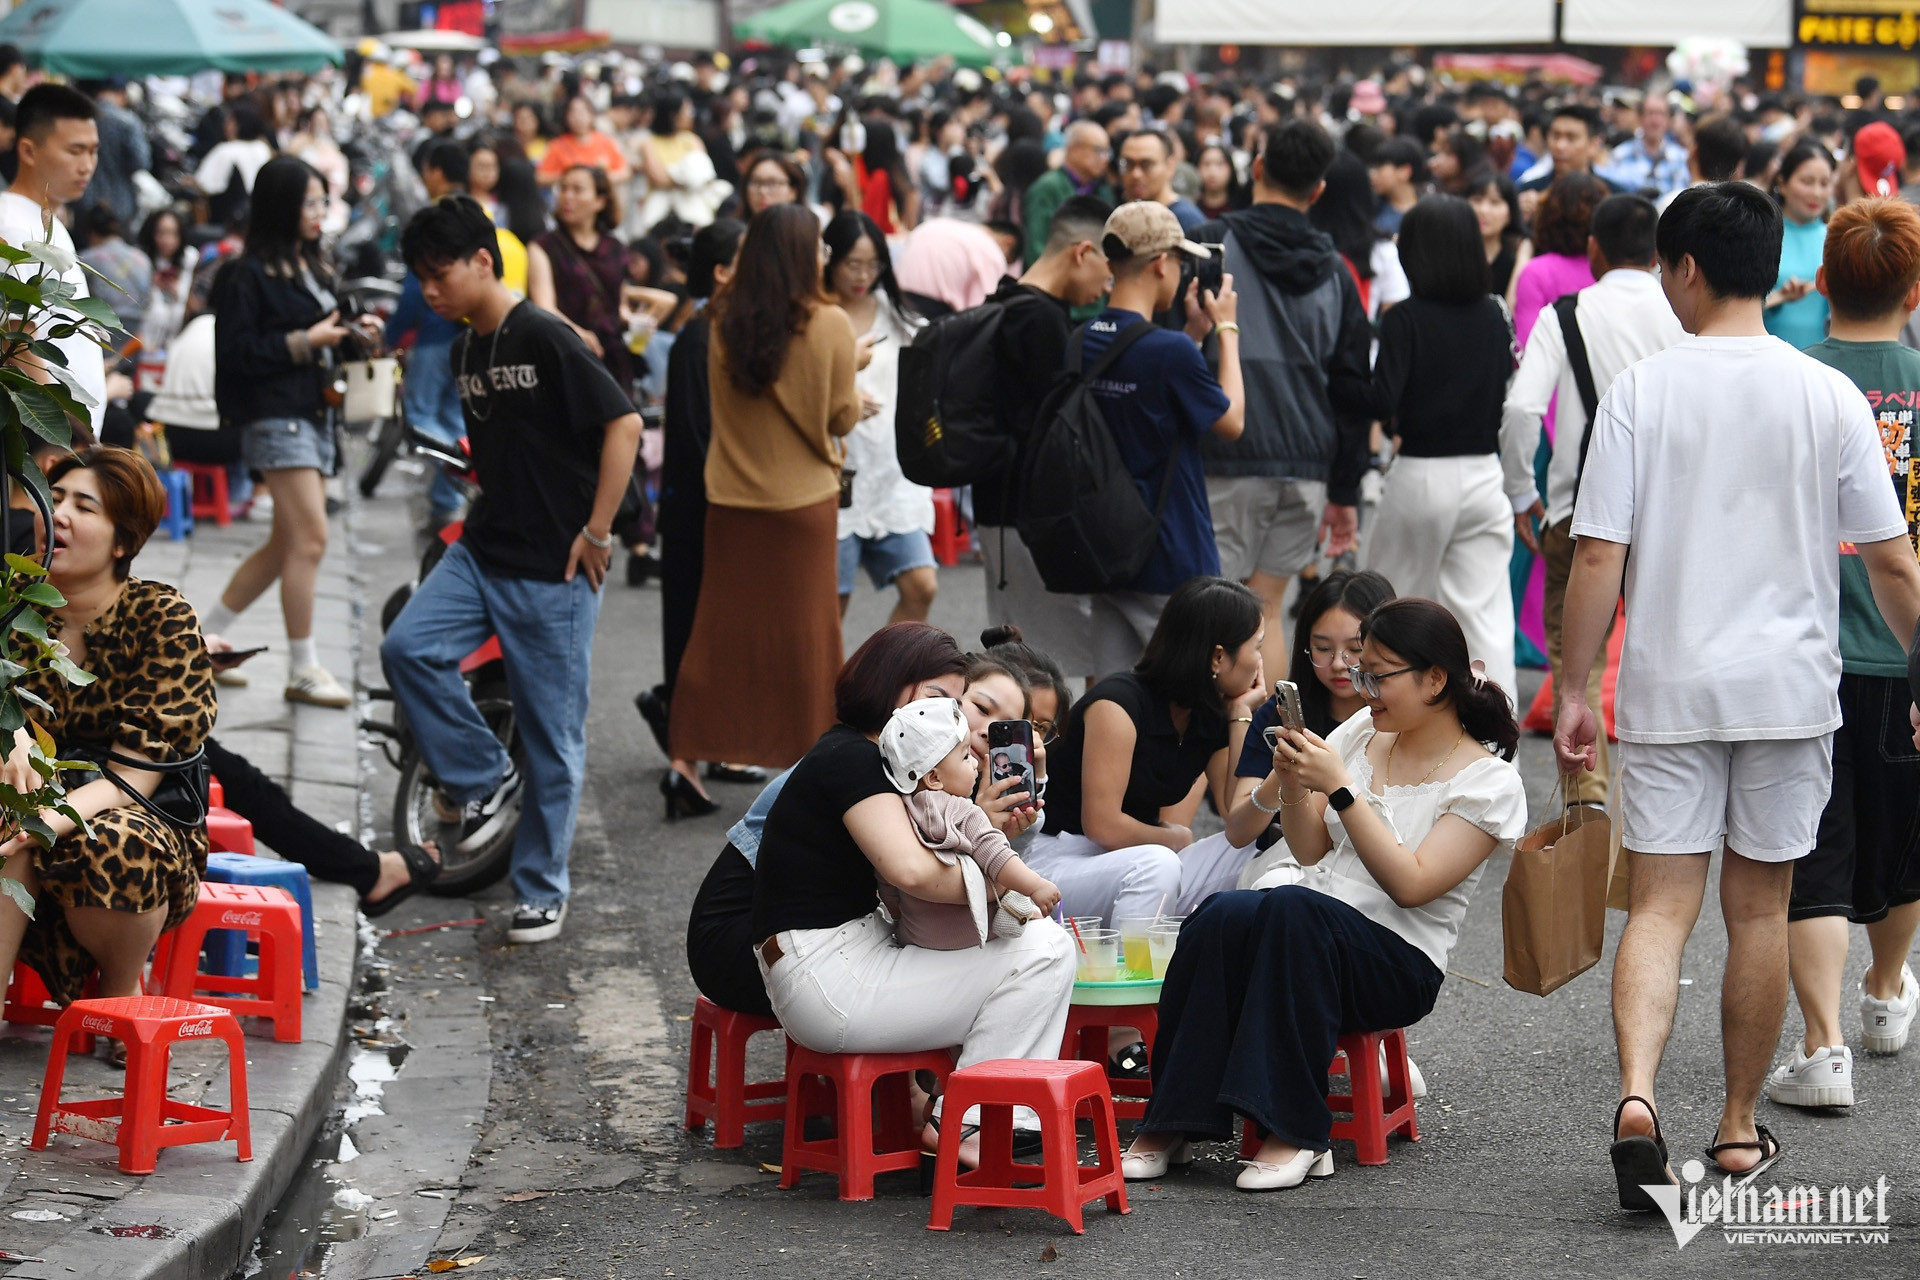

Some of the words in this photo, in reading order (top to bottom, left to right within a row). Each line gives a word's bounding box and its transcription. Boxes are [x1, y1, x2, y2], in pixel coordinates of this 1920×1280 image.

[221, 909, 263, 925] Coca-Cola
[82, 1014, 114, 1033] Coca-Cola
[178, 1019, 214, 1038] Coca-Cola
